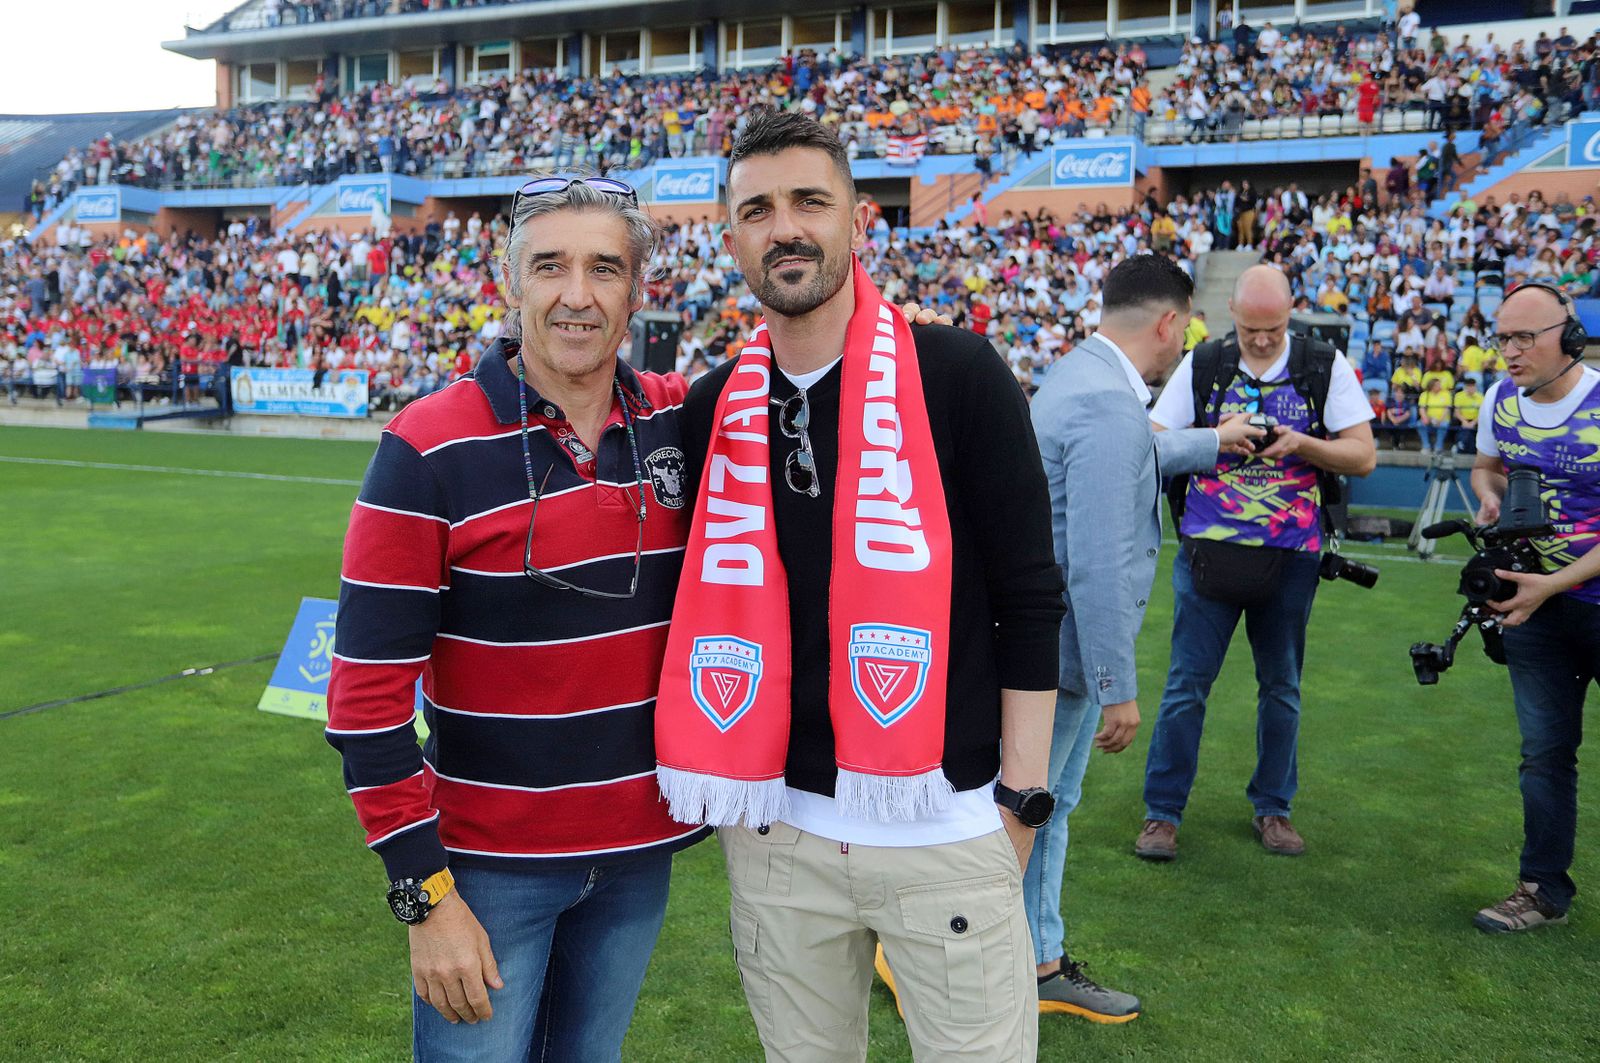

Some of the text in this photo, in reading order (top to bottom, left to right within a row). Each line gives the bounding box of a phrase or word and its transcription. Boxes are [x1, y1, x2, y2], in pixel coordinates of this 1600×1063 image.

[1056, 152, 1127, 179] Coca-Cola
[855, 304, 931, 572] MADRID
[700, 453, 767, 587] DV7
[697, 656, 755, 670] DV7 ACADEMY
[855, 645, 925, 659] DV7 ACADEMY
